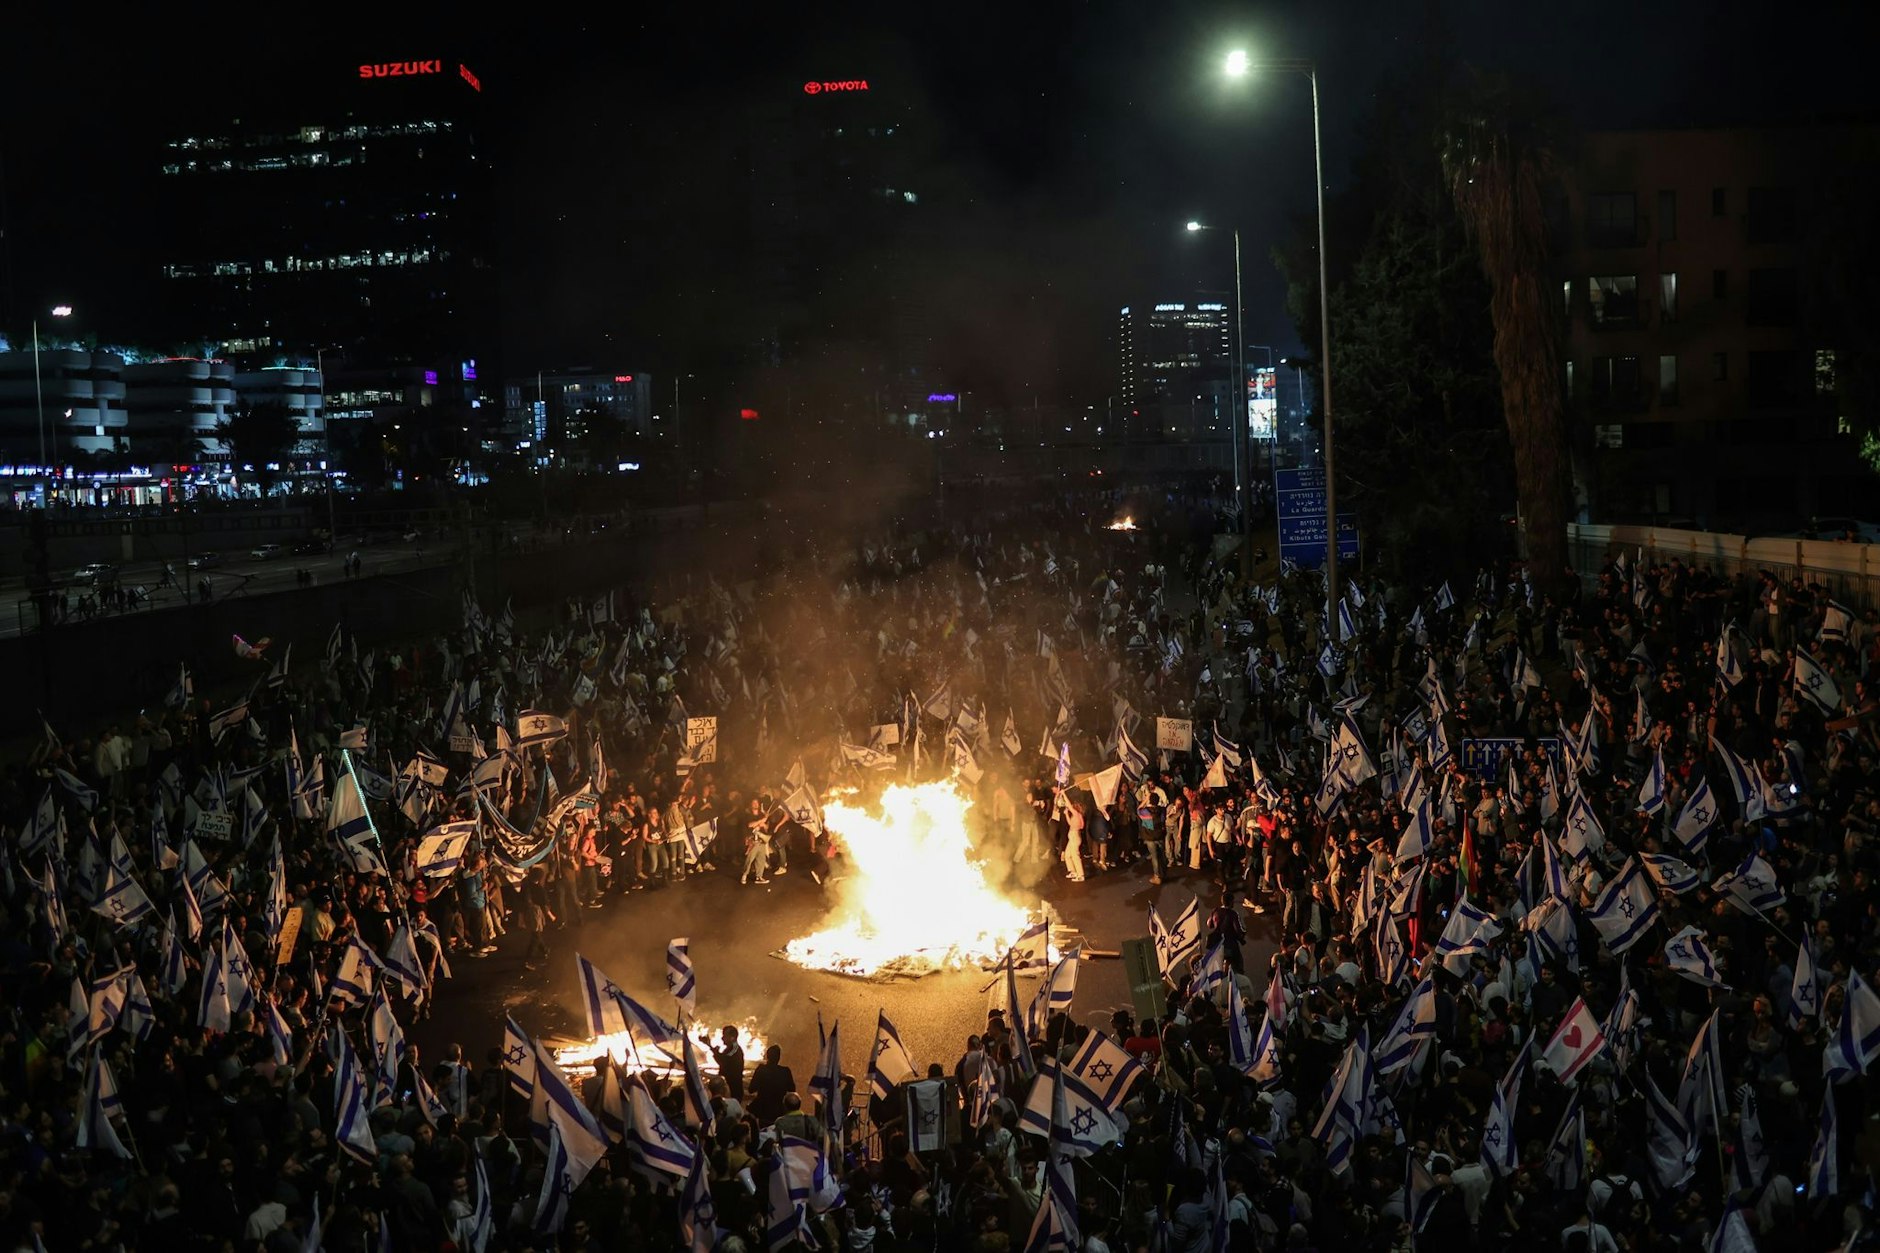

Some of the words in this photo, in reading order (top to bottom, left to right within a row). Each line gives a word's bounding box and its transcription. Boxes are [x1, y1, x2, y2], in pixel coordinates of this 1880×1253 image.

[359, 60, 442, 78] SUZUKI
[823, 80, 869, 93] TOYOTA
[694, 718, 713, 727] אולי
[688, 727, 705, 735] כבר
